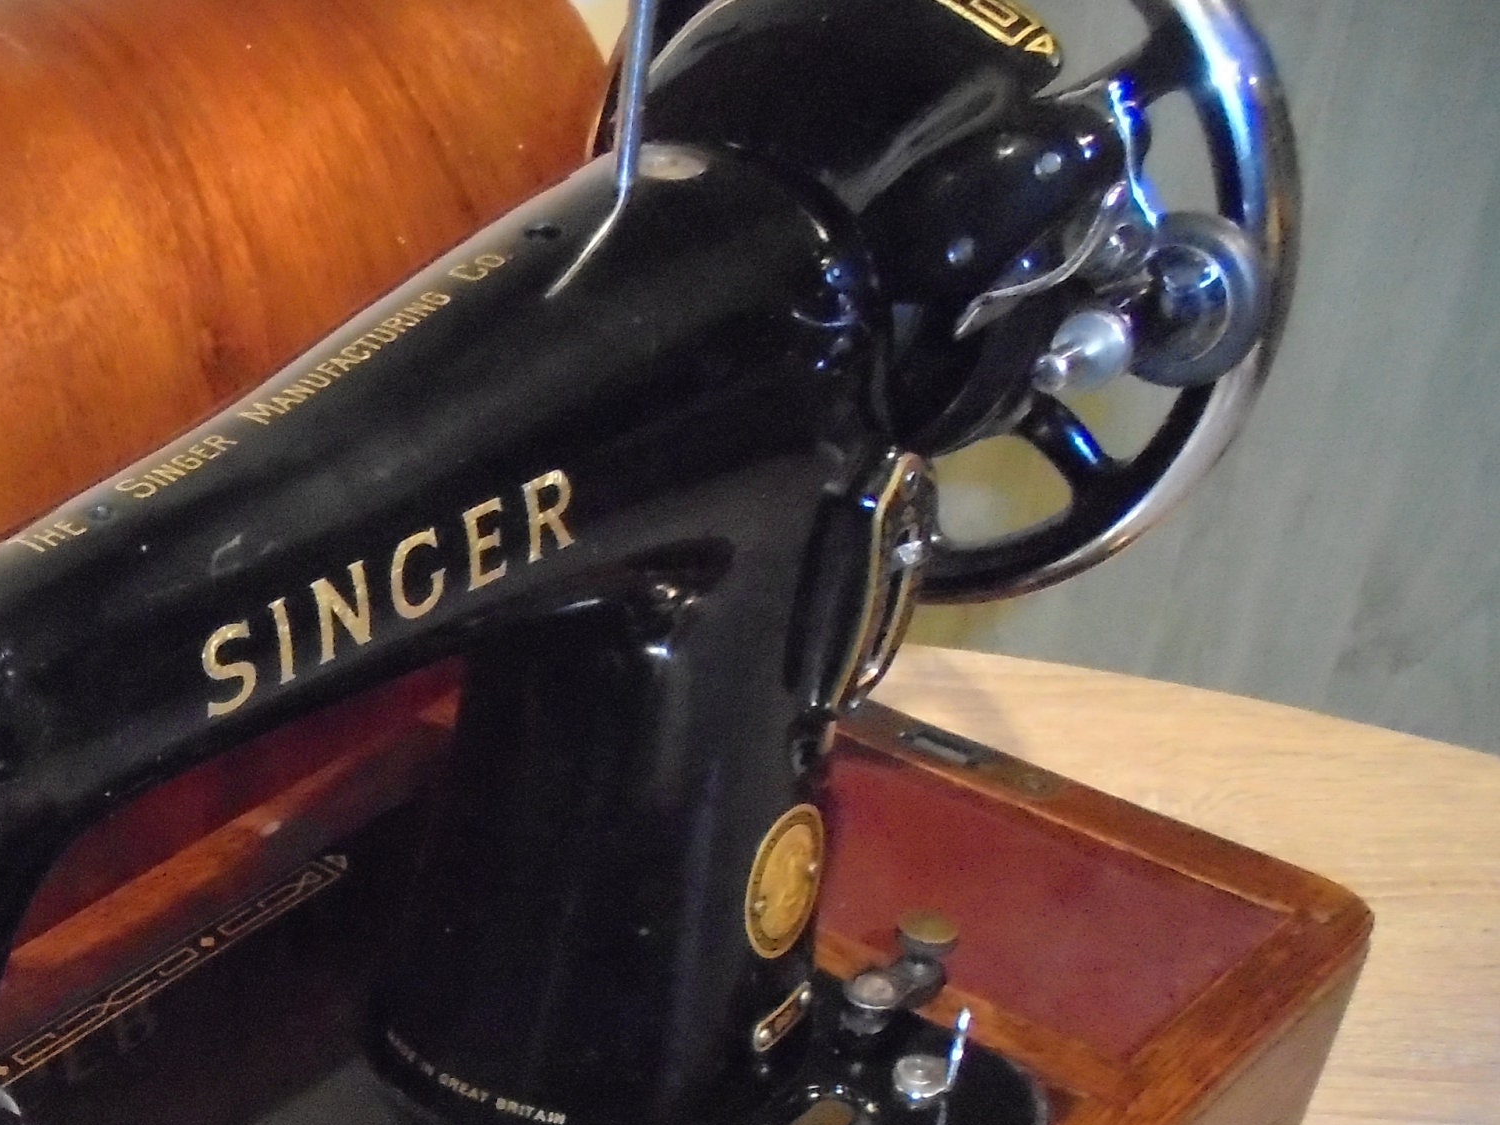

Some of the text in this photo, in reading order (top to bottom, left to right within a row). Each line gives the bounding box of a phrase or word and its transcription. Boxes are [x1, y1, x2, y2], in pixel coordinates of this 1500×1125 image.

[8, 518, 88, 553] THE
[115, 434, 238, 499] SINGER
[239, 291, 451, 426] MANUFACTURING
[201, 469, 575, 718] SINGER
[495, 1097, 567, 1125] BRITAIN
